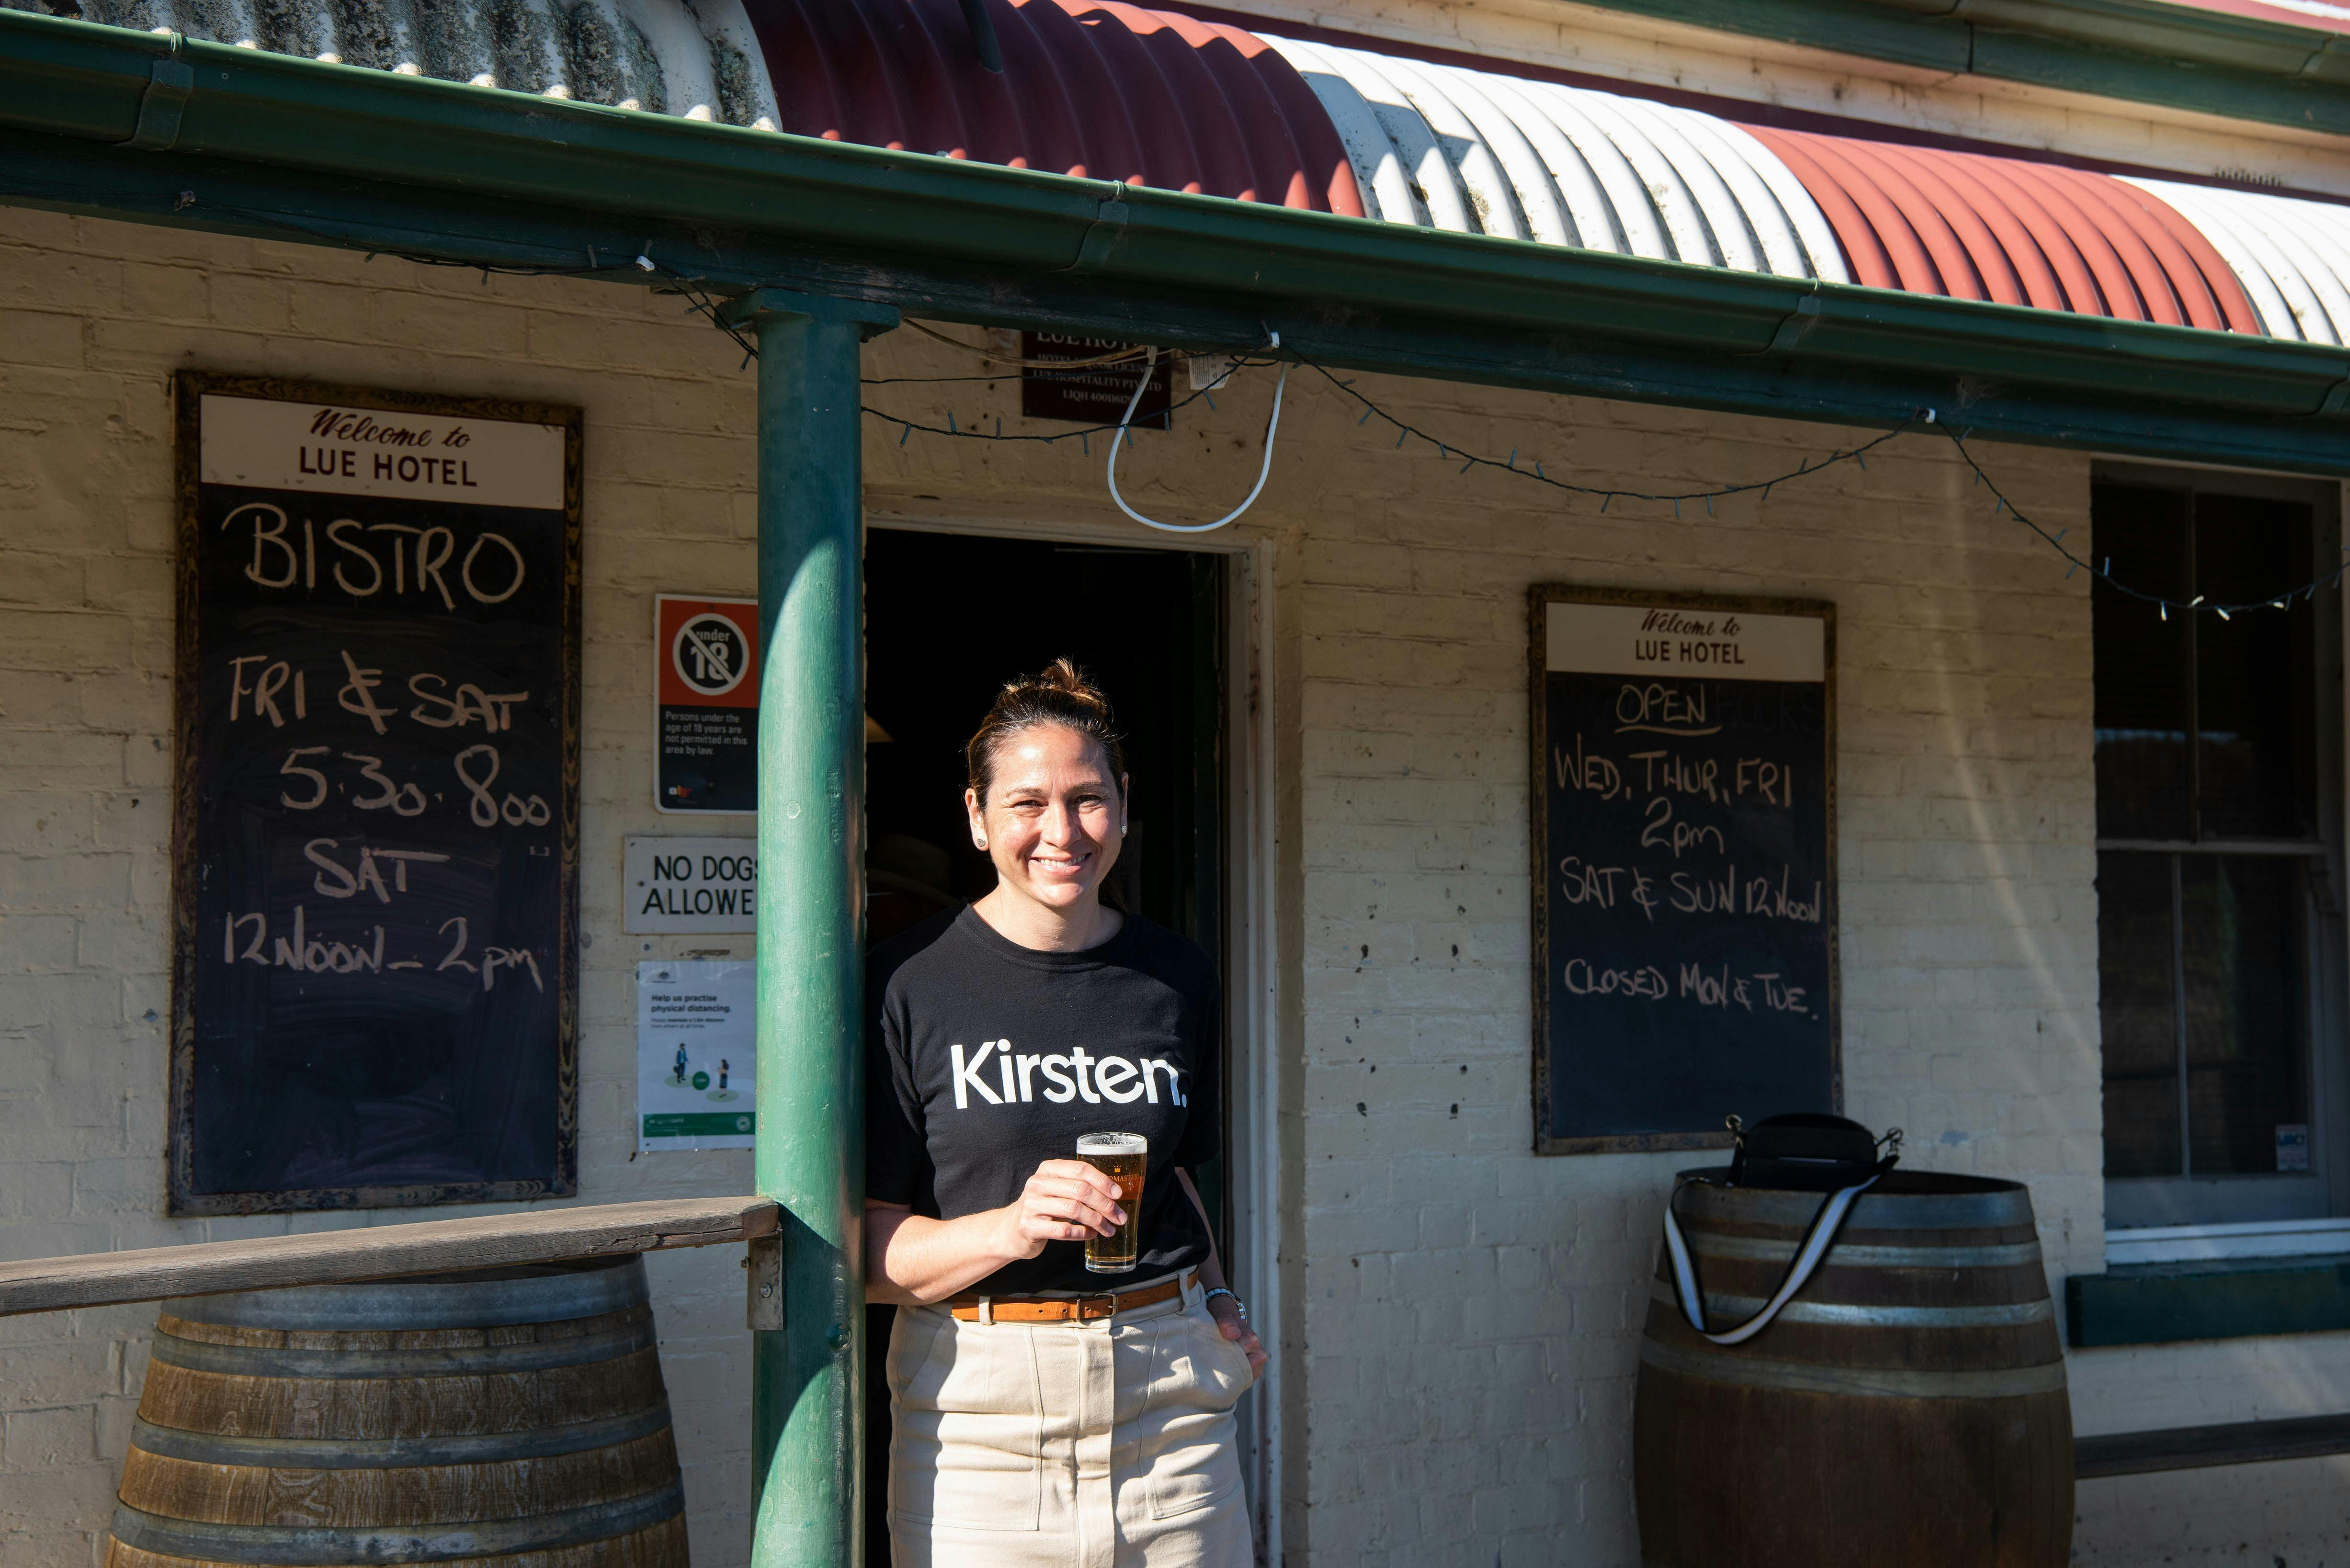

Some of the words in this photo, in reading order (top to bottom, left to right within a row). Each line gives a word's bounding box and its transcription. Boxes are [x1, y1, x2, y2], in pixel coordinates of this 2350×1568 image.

[1146, 382, 1163, 392] TD
[309, 409, 432, 447] Welcome
[441, 426, 471, 448] to
[299, 446, 356, 477] LUE
[373, 453, 477, 487] HOTEL
[221, 502, 525, 613] BISTRO
[696, 629, 731, 642] under
[1640, 609, 1714, 636] Welcome
[1721, 616, 1741, 636] to
[690, 642, 729, 680] 18
[1635, 640, 1670, 661] LUE
[1680, 642, 1745, 664] HOTEL
[228, 655, 307, 727] FRI
[408, 672, 529, 733] SAT
[1616, 684, 1706, 723] OPEN
[665, 711, 700, 722] Persons
[701, 713, 725, 722] under
[726, 713, 740, 722] the
[665, 724, 681, 733] age
[682, 723, 692, 732] of
[693, 724, 703, 733] 18
[704, 726, 727, 734] years
[665, 735, 680, 743] not
[680, 735, 722, 745] permitted
[724, 735, 731, 744] in
[732, 736, 748, 745] this
[665, 745, 684, 754] area
[685, 745, 696, 756] by
[697, 746, 715, 755] law.
[1736, 757, 1791, 808] FRI
[305, 837, 450, 903] SAT
[654, 855, 692, 881] NO
[703, 856, 758, 881] DOG
[1560, 856, 1625, 909] SAT
[1670, 864, 1735, 914] SUN
[642, 888, 754, 915] ALLOWE
[1565, 958, 1669, 1000] CLOSED
[1680, 962, 1728, 1010] MON
[651, 1004, 685, 1013] physical
[687, 1004, 732, 1013] distancing.
[951, 1038, 1187, 1109] Kirsten.
